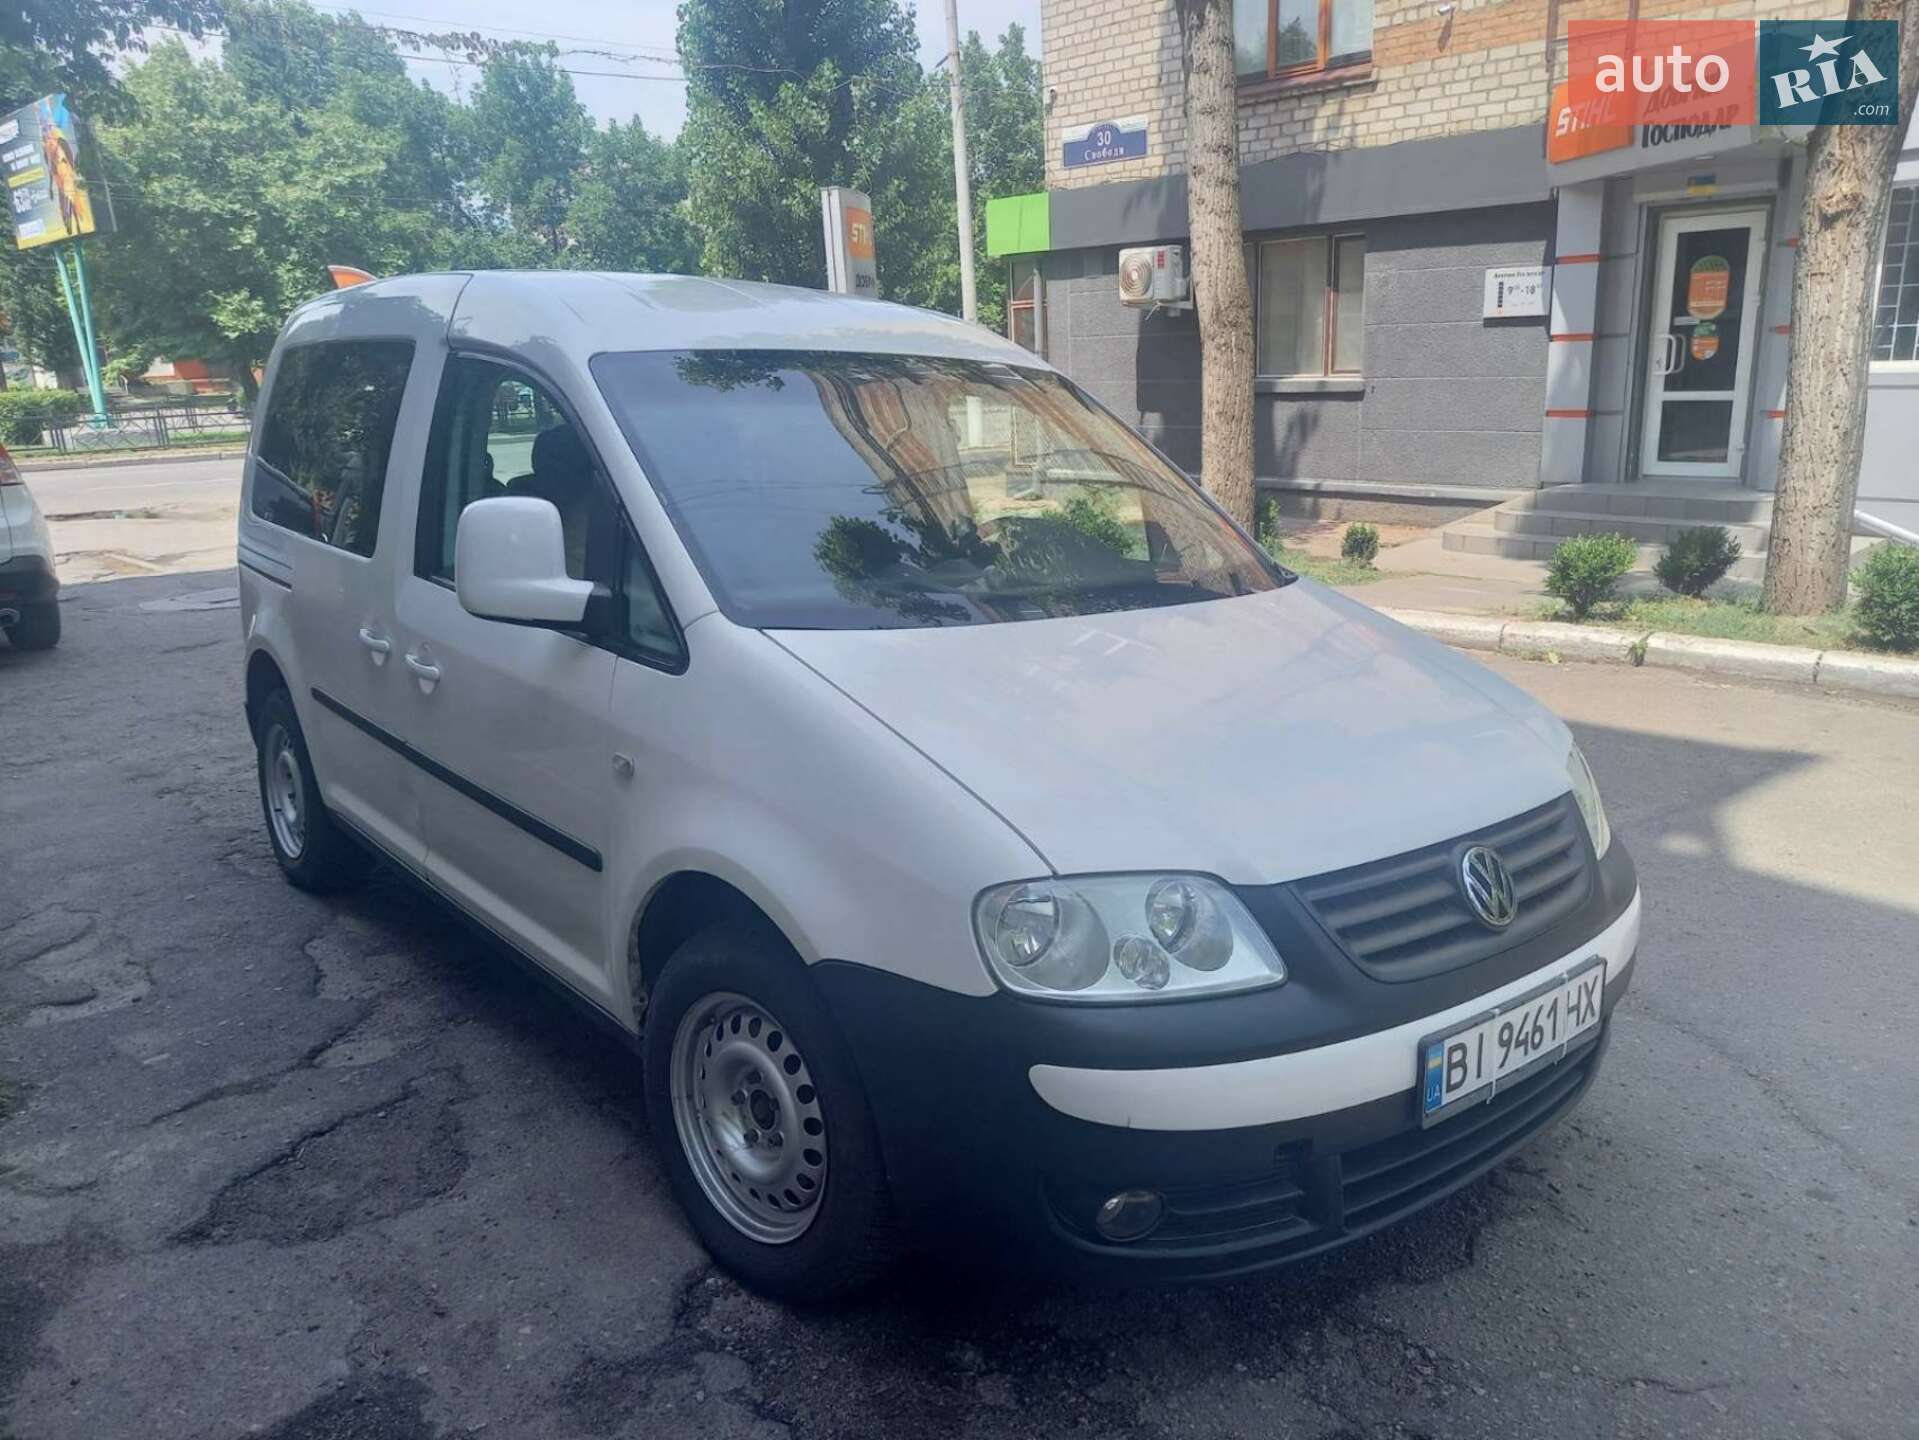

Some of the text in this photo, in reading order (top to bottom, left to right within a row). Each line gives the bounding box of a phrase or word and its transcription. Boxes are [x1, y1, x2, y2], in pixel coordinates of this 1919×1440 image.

[1097, 131, 1112, 147] 30
[1446, 975, 1599, 1093] BI 9461 HX
[1426, 1086, 1440, 1102] UA
